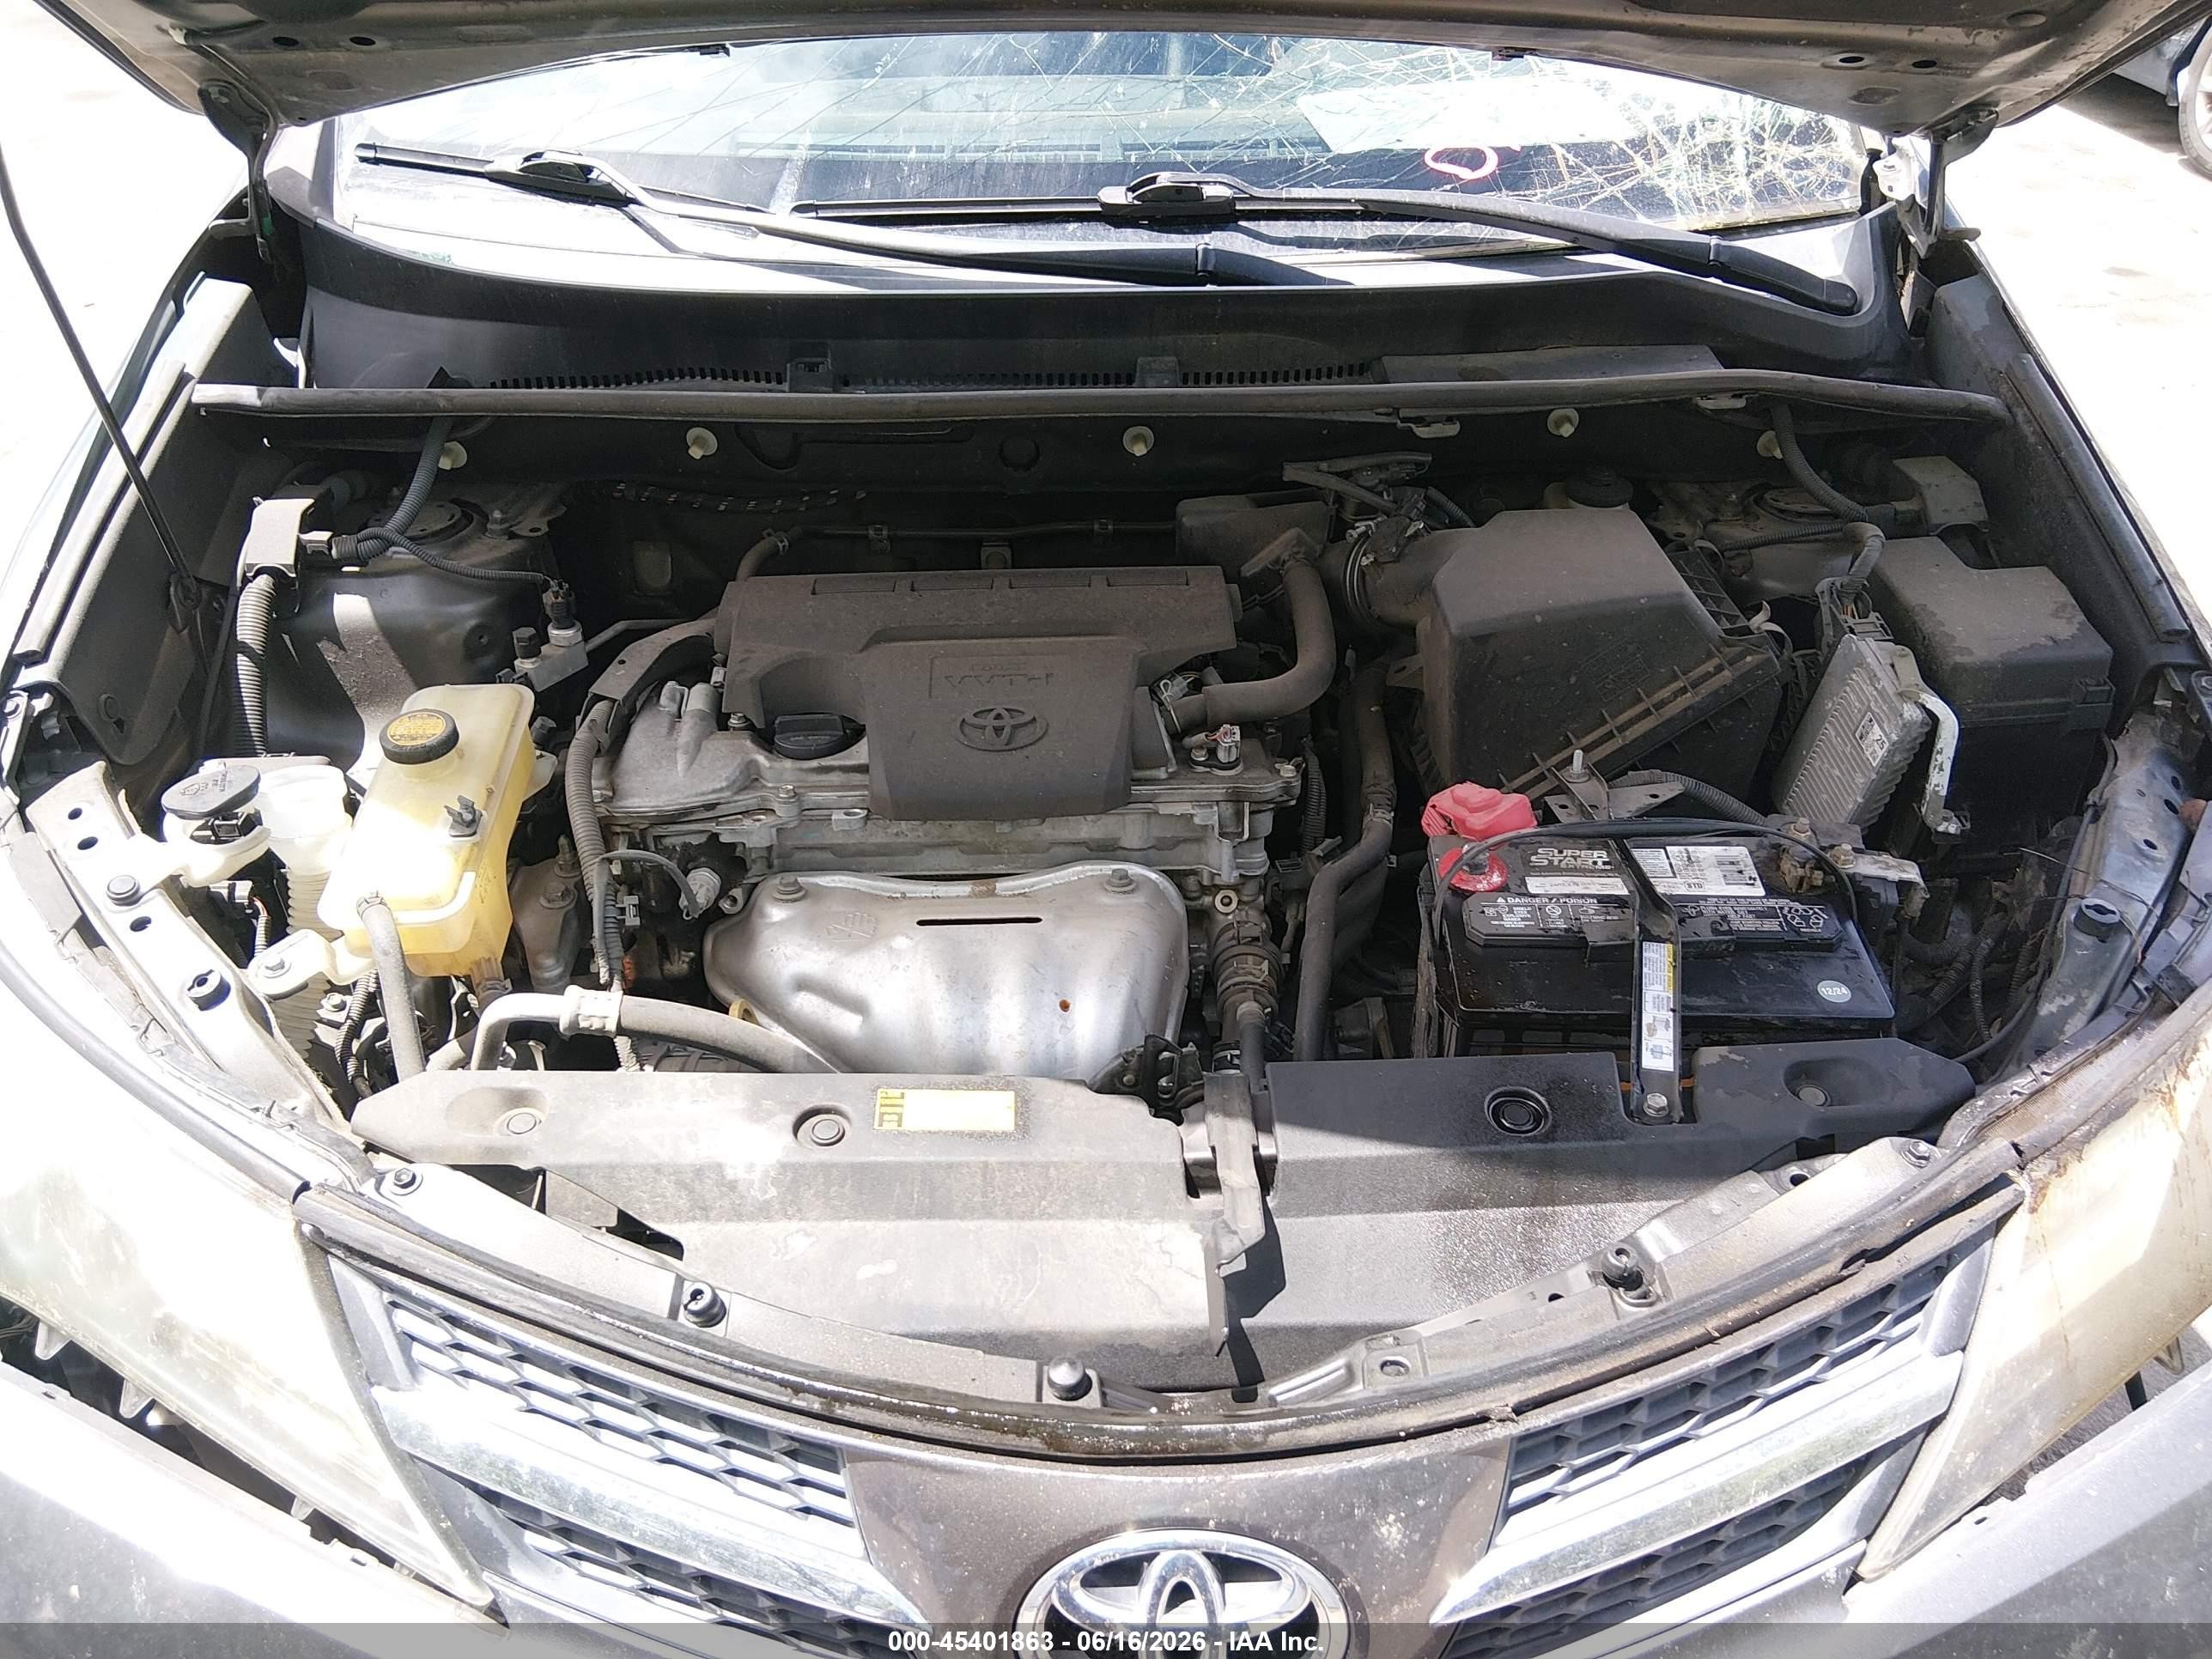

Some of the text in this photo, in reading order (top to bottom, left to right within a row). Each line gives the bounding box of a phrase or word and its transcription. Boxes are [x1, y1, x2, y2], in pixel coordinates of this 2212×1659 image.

[1536, 848, 1607, 858] SUPER
[1529, 855, 1610, 866] START
[1820, 987, 1848, 996] 12/24
